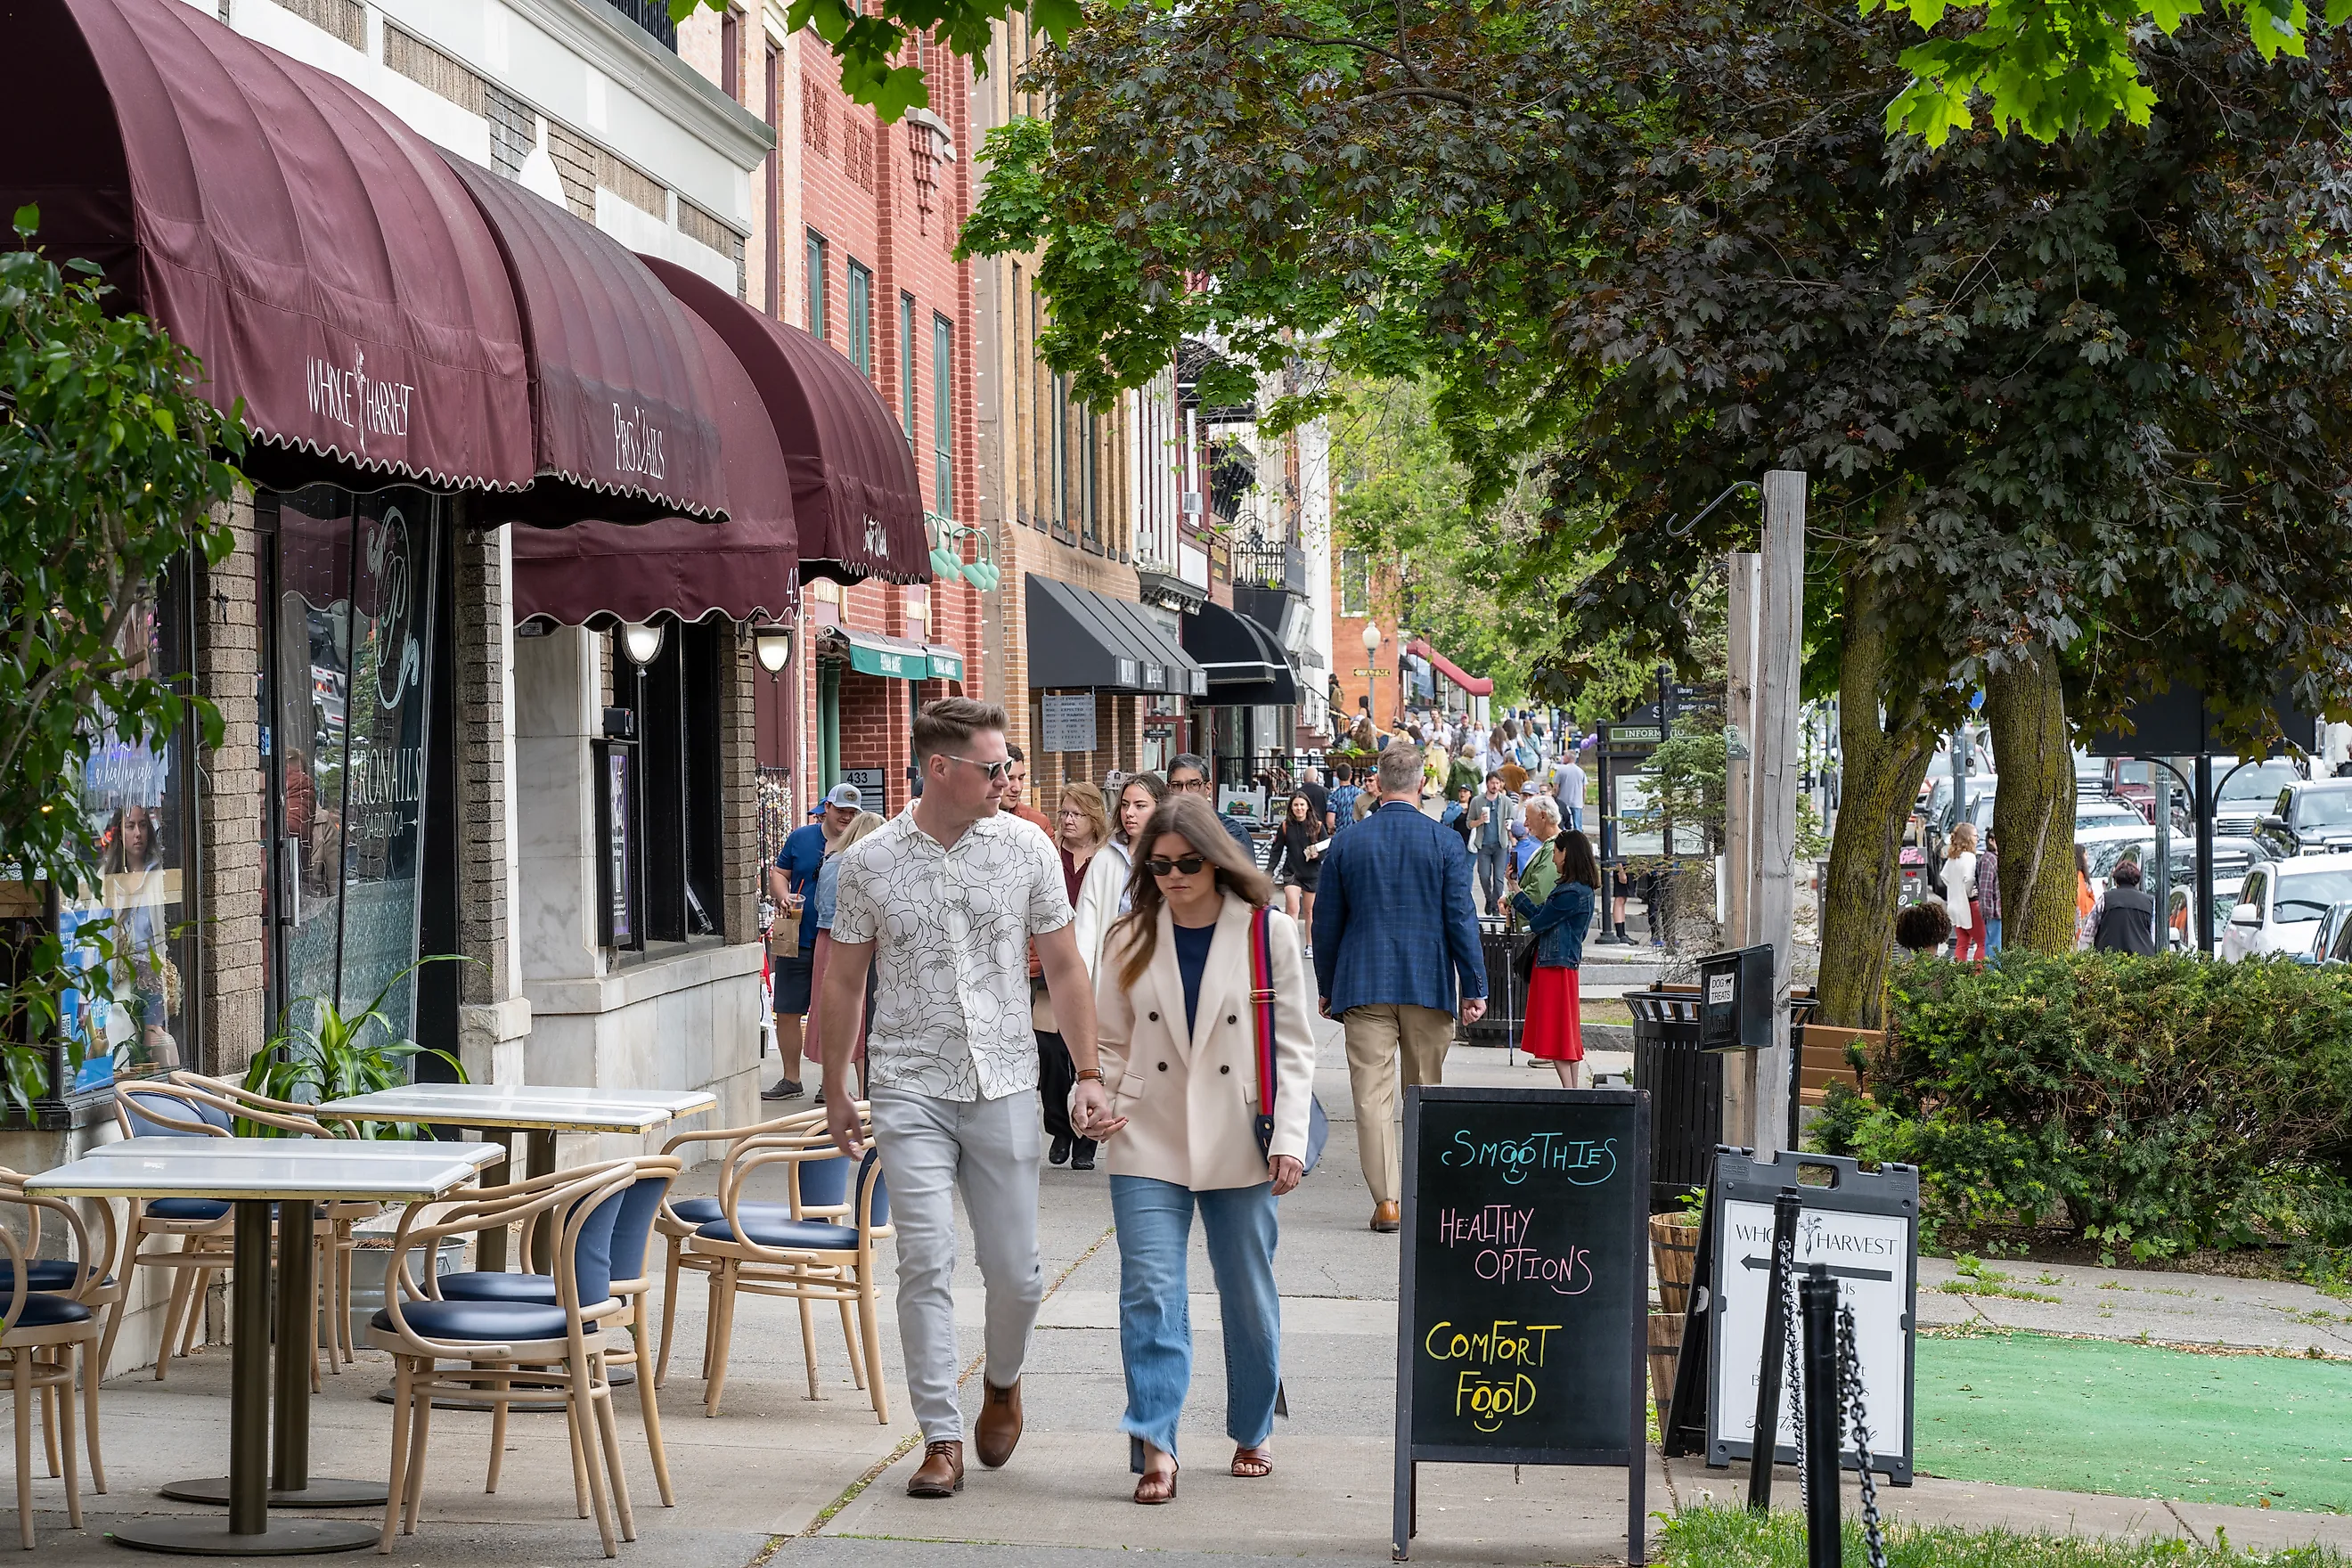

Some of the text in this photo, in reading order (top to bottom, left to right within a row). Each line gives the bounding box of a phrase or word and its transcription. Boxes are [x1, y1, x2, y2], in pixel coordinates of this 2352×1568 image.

[1677, 687, 1694, 695] Library
[349, 747, 422, 805] PRONAILS
[846, 772, 868, 784] 433
[364, 811, 404, 839] SARATOGA
[1711, 978, 1725, 989] DOG
[1711, 990, 1731, 1001] TREATS
[1441, 1130, 1618, 1186] SMOOTHIES
[1441, 1205, 1535, 1248] HEALTHY
[1817, 1232, 1898, 1255] HARVEST
[1474, 1245, 1593, 1295] OPTIONS
[1425, 1319, 1564, 1368] COMFORT
[1456, 1370, 1537, 1417] FOOD
